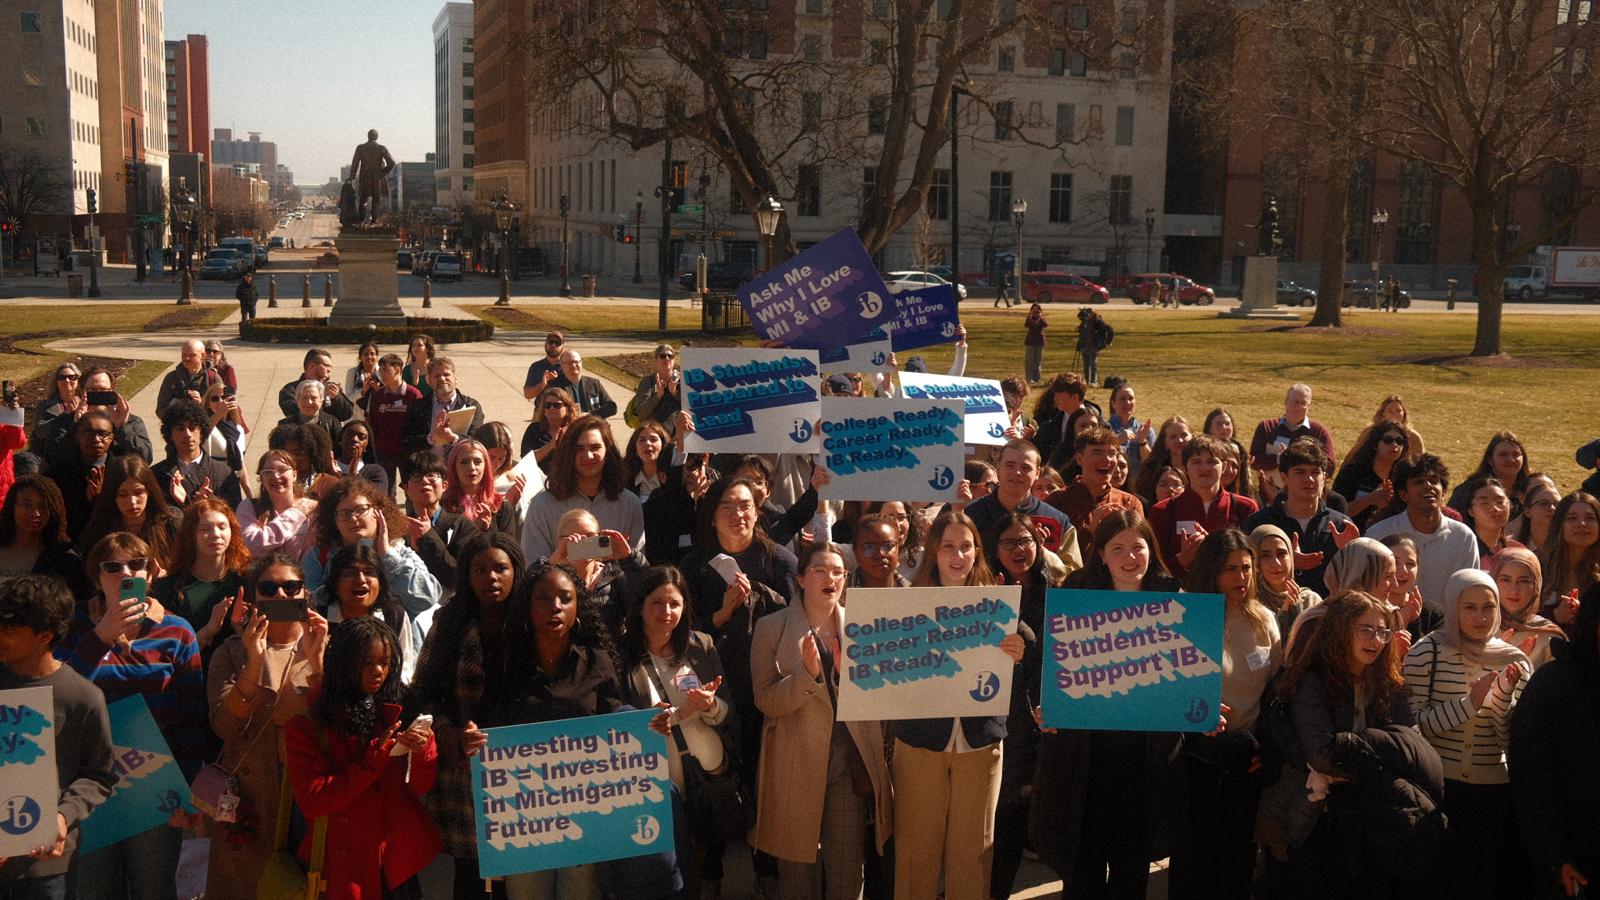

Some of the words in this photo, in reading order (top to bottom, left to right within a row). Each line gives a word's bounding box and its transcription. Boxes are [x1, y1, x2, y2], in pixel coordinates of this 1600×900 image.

[749, 281, 784, 308] Ask
[783, 265, 812, 286] Me
[755, 296, 796, 324] Why
[797, 287, 808, 301] I
[808, 265, 851, 295] Love
[906, 295, 923, 305] Me
[766, 319, 791, 340] MI
[793, 310, 809, 325] &
[810, 296, 832, 316] IB
[858, 291, 882, 317] ib
[910, 306, 915, 316] I
[918, 303, 944, 315] Love
[904, 319, 912, 329] &
[916, 316, 928, 326] IB
[683, 367, 706, 384] IB
[711, 355, 808, 381] Students:
[687, 378, 780, 408] Prepared
[785, 376, 806, 395] to
[903, 384, 920, 395] IB
[923, 382, 993, 394] Students:
[979, 395, 994, 406] to
[692, 407, 742, 430] Lead
[790, 418, 812, 442] ib
[820, 415, 889, 434] College
[893, 405, 952, 423] Ready.
[823, 433, 883, 451] Career
[888, 423, 947, 441] Ready.
[825, 453, 845, 468] IB
[849, 445, 909, 464] Ready.
[929, 465, 954, 490] ib
[844, 613, 928, 639] College
[934, 597, 1005, 622] Ready.
[1047, 599, 1173, 634] Empower
[846, 634, 921, 660] Career
[927, 619, 997, 645] Ready.
[1052, 624, 1181, 662] Students.
[848, 663, 872, 681] IB
[879, 650, 949, 675] Ready.
[1056, 651, 1163, 689] Support
[1169, 645, 1208, 669] IB.
[970, 670, 1000, 701] ib
[479, 734, 599, 763] Investing
[607, 727, 630, 747] in
[480, 768, 508, 789] IB
[516, 768, 532, 781] =
[541, 751, 659, 781] Investing
[483, 795, 506, 815] in
[485, 814, 571, 841] Future
[632, 814, 660, 844] ib
